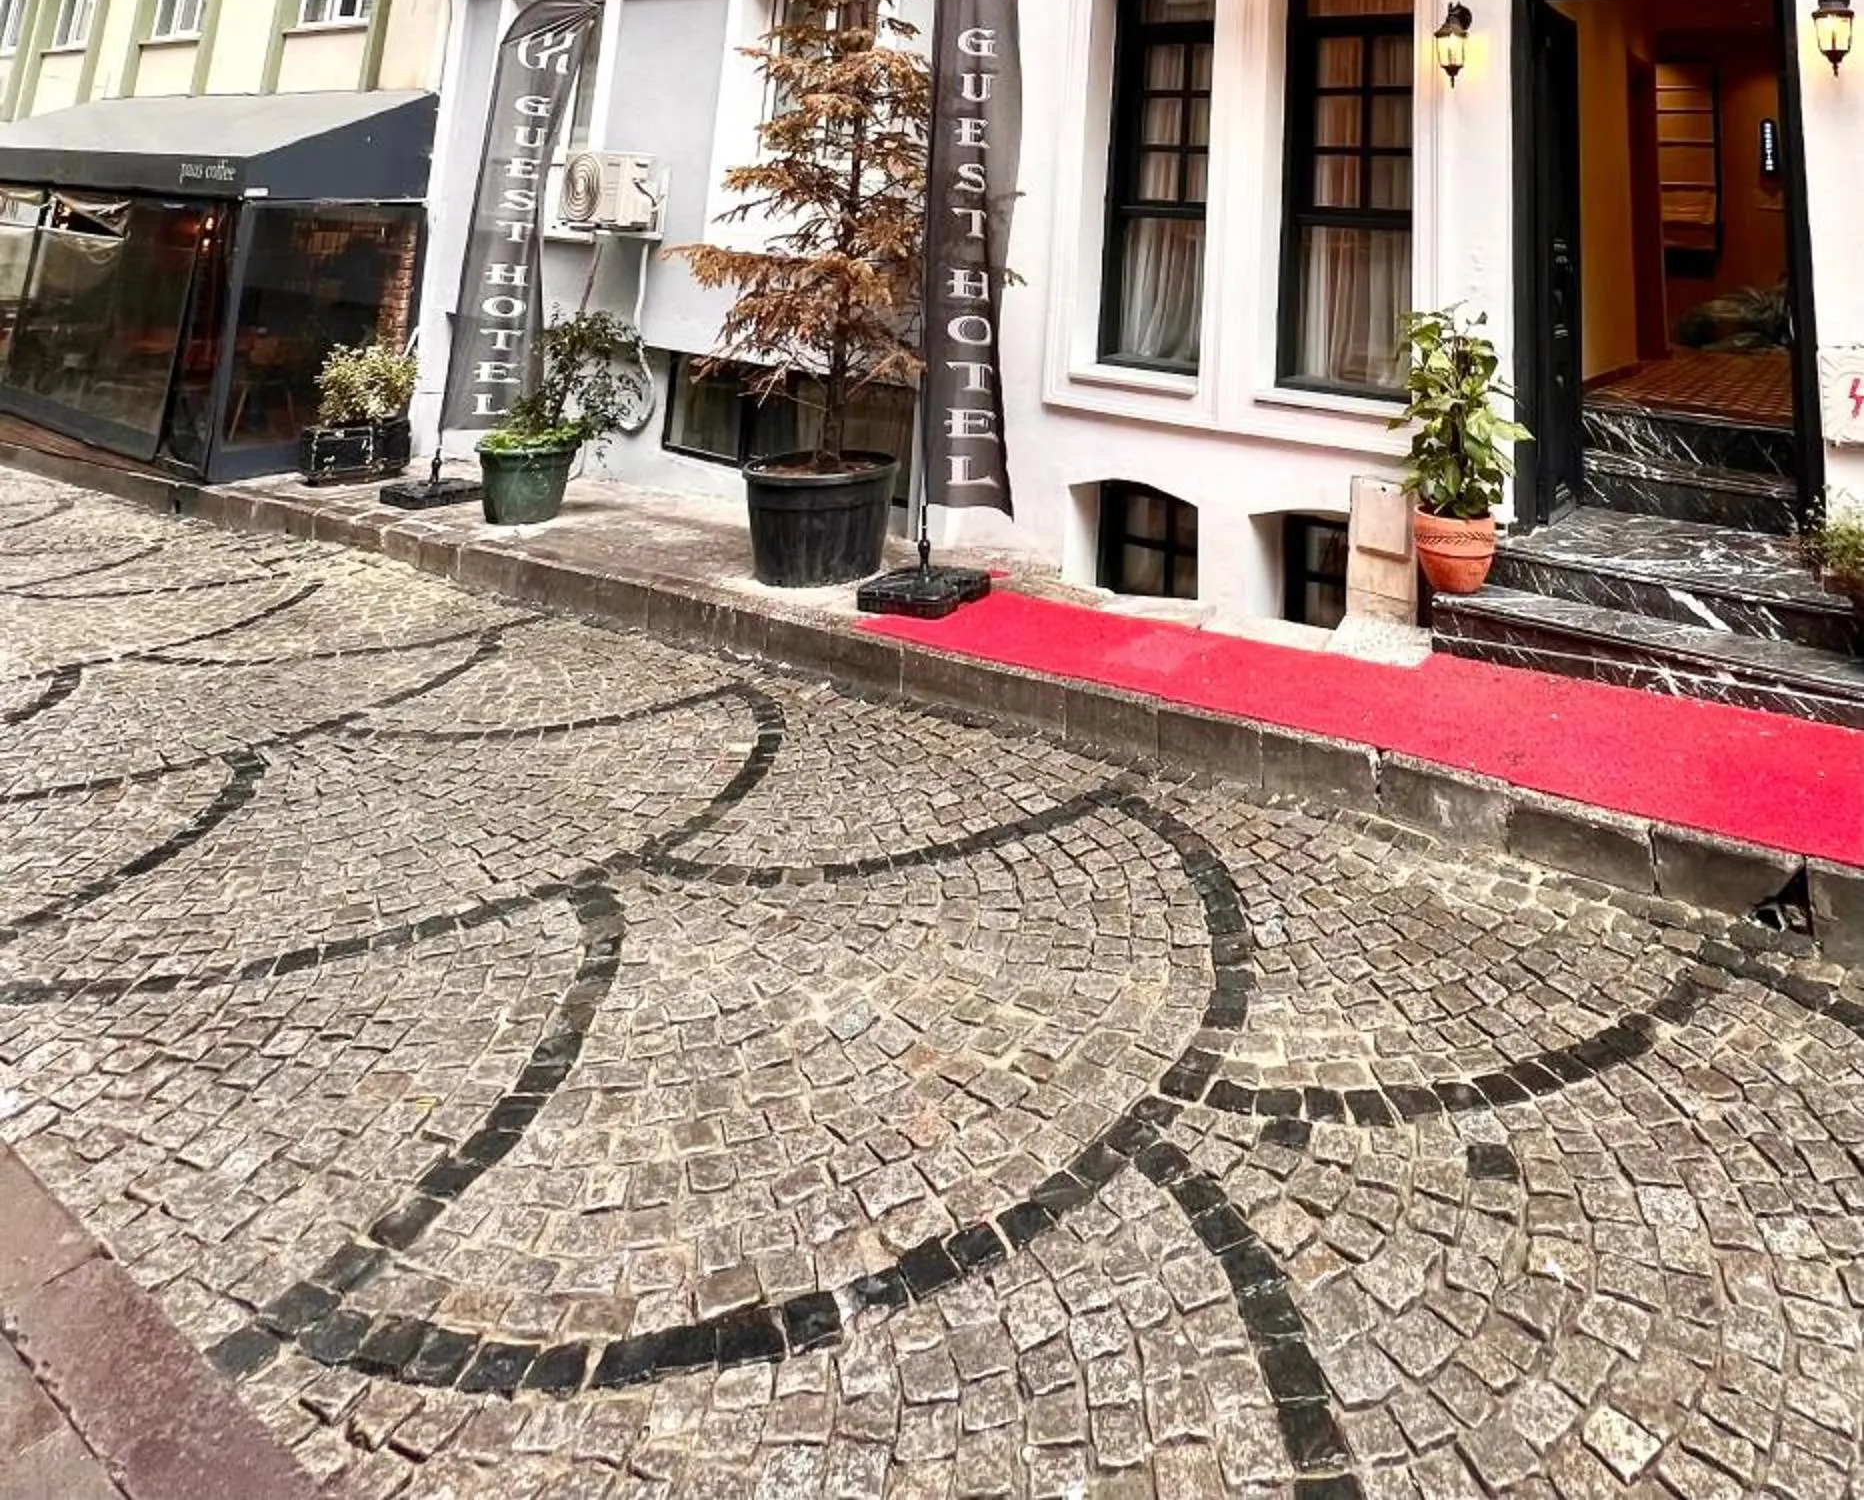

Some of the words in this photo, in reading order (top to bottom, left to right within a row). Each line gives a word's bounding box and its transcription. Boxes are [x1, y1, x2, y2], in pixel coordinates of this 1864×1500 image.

[495, 94, 553, 244] GUEST
[951, 26, 998, 240] GUEST
[471, 263, 529, 417] HOTEL
[943, 267, 1000, 487] HOTEL
